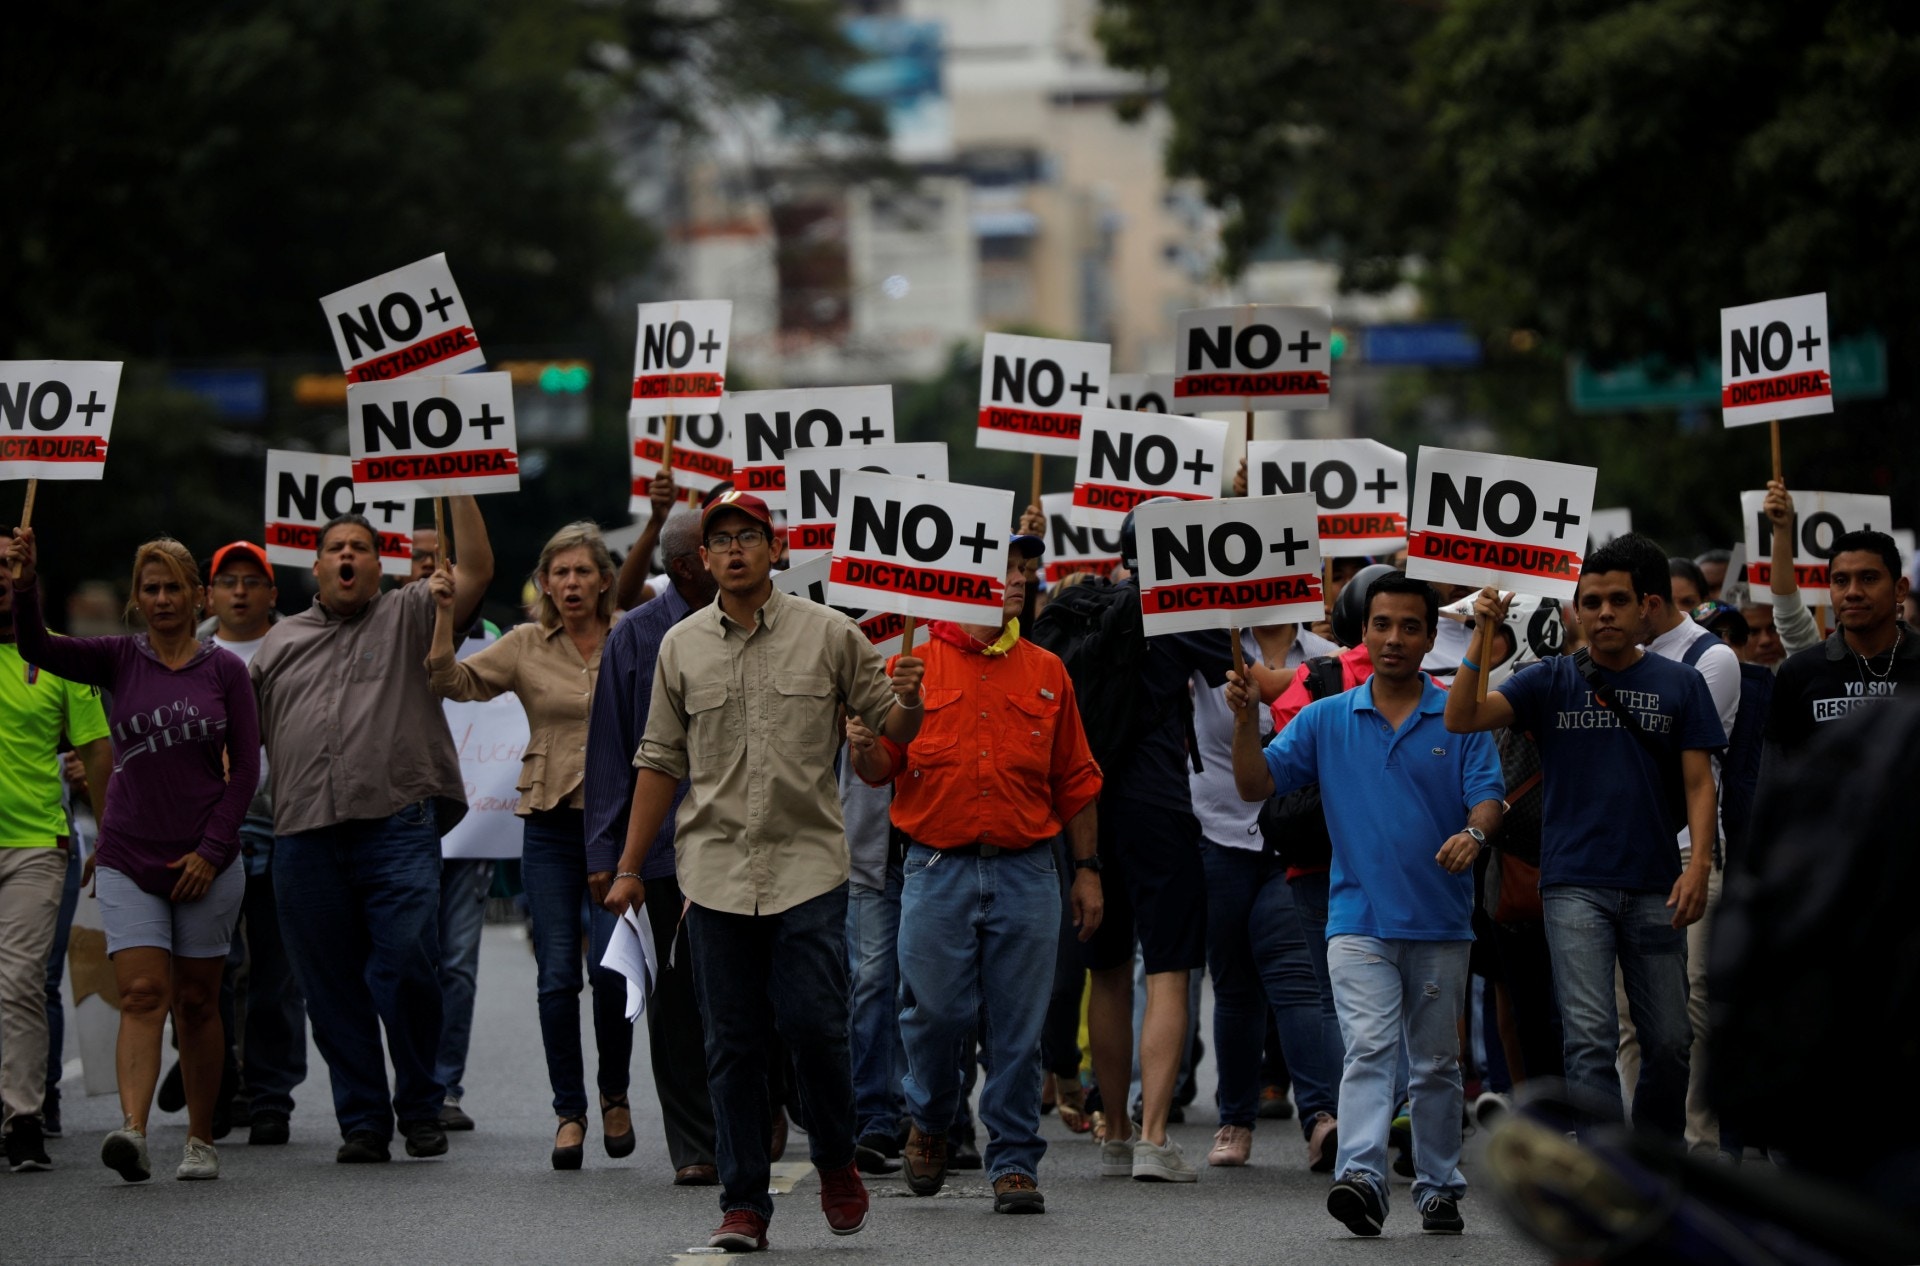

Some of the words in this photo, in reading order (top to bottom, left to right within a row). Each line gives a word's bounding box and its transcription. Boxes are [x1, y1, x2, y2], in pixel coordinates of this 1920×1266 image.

[338, 287, 454, 360] NO+
[357, 331, 470, 382] DICTADURA
[643, 320, 721, 370] NO+
[1188, 324, 1321, 371] NO+
[1731, 320, 1821, 377] NO+
[640, 376, 717, 396] DICTADURA
[992, 355, 1099, 407] NO+
[1187, 374, 1320, 395] DICTADURA
[1732, 374, 1823, 404] DICTADURA
[362, 397, 504, 452] NO+
[990, 411, 1081, 436] DICTADUR
[367, 453, 508, 479] DICTADURA
[1090, 429, 1213, 486] NO+
[1427, 471, 1580, 539] NO+
[849, 495, 999, 564] NO+
[1318, 516, 1397, 535] ADURA
[1152, 521, 1309, 581] NO+
[1424, 536, 1570, 575] DICTADURA
[846, 561, 993, 600] DICTADURA
[1157, 579, 1311, 610] DICTADURA
[1615, 689, 1660, 711] THE
[1844, 681, 1864, 696] YO
[1868, 681, 1898, 696] SOY
[113, 696, 200, 742] 100%
[146, 716, 216, 754] FREE
[1556, 710, 1673, 734] NIGHIFE
[457, 723, 525, 764] LUCH
